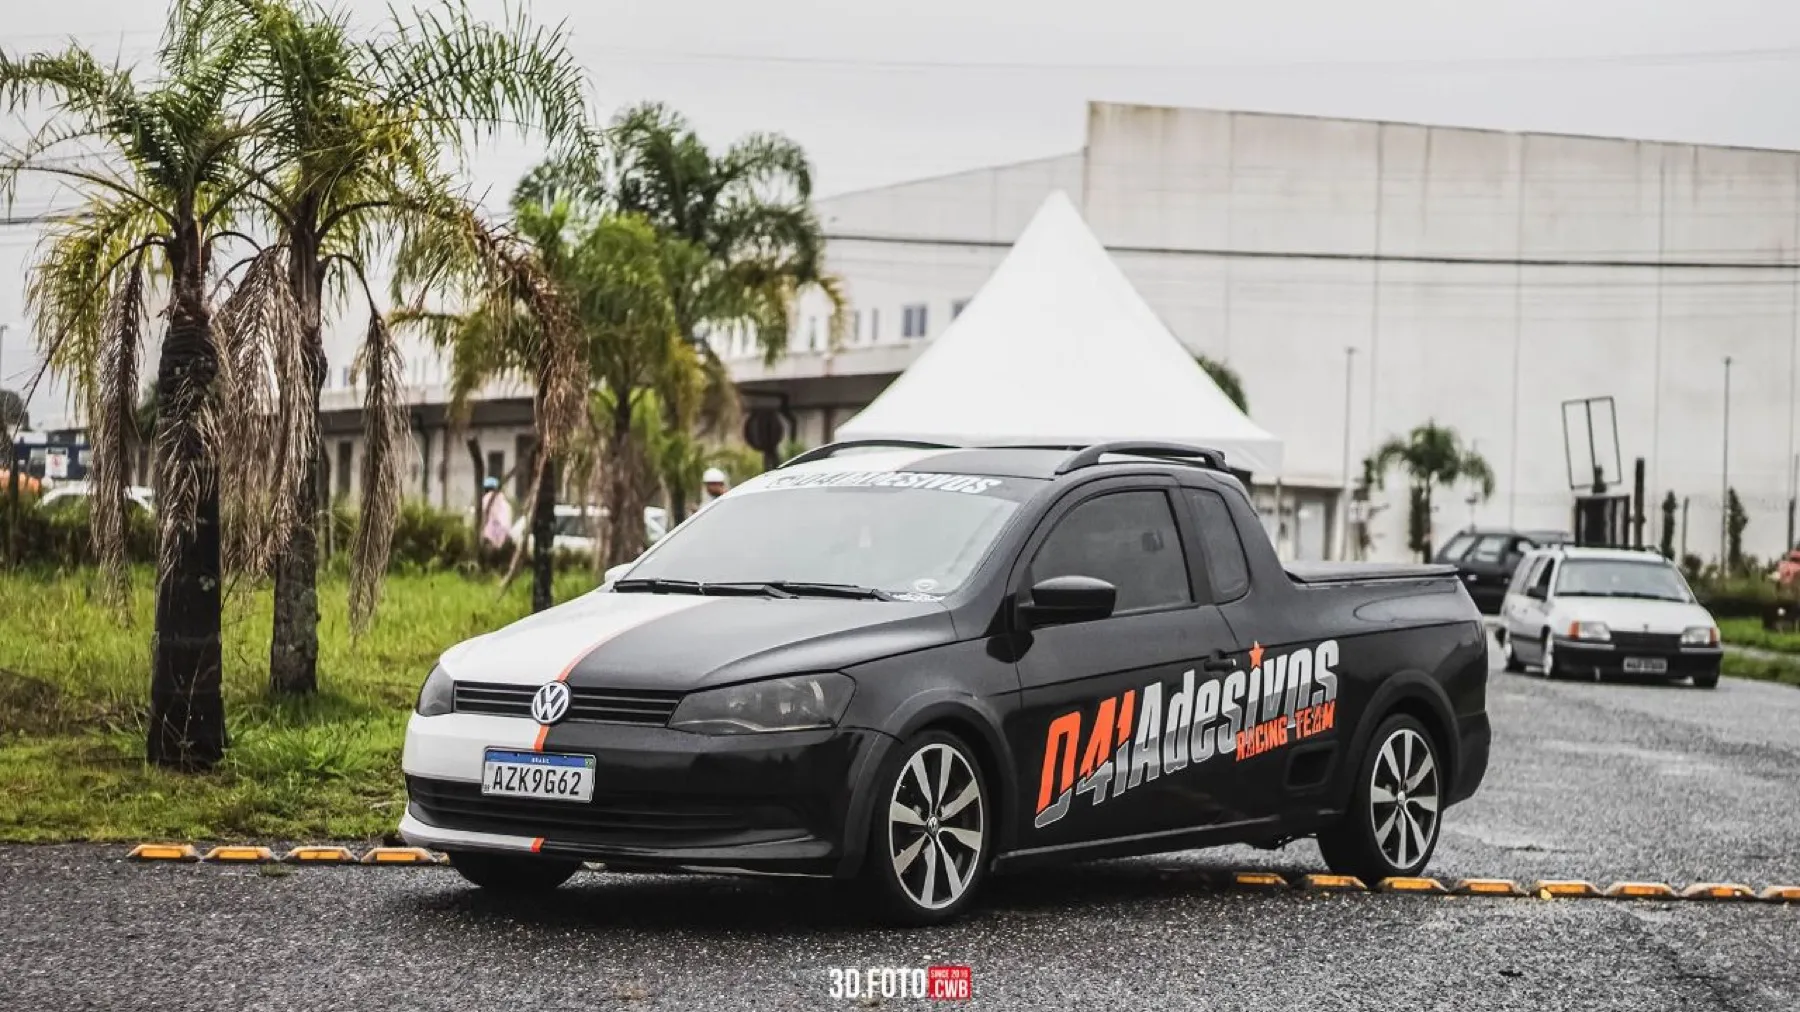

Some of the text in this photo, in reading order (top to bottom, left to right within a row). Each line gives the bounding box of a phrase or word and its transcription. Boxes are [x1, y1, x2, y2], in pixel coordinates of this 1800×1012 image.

[1236, 699, 1335, 762] RACING TEAM
[492, 765, 582, 796] AZK9G62
